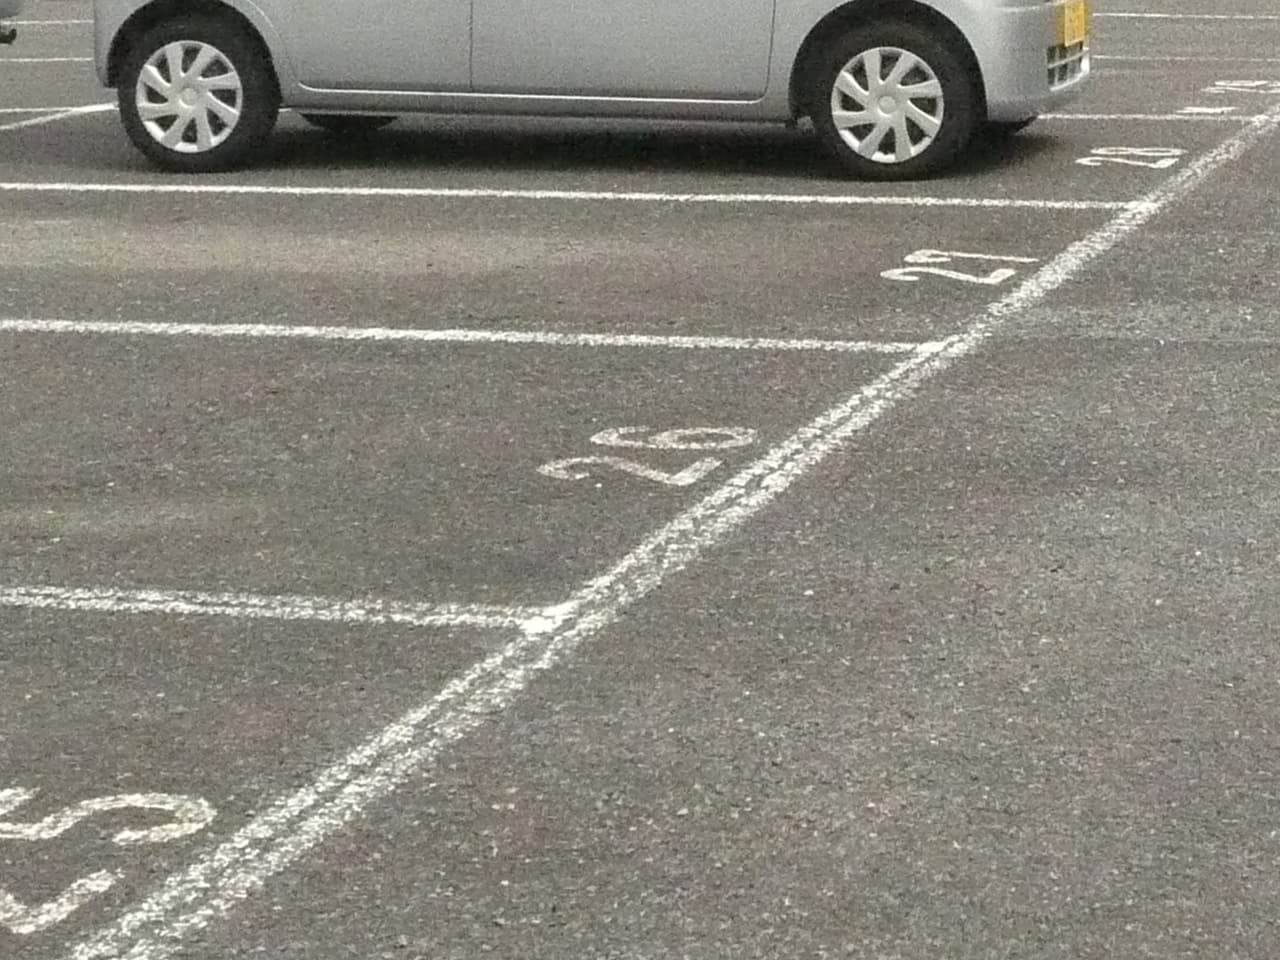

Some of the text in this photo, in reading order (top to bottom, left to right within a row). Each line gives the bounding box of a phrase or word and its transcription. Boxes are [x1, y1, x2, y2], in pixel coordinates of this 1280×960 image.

[1075, 147, 1188, 169] 28
[880, 249, 1040, 285] 27
[536, 426, 758, 486] 26
